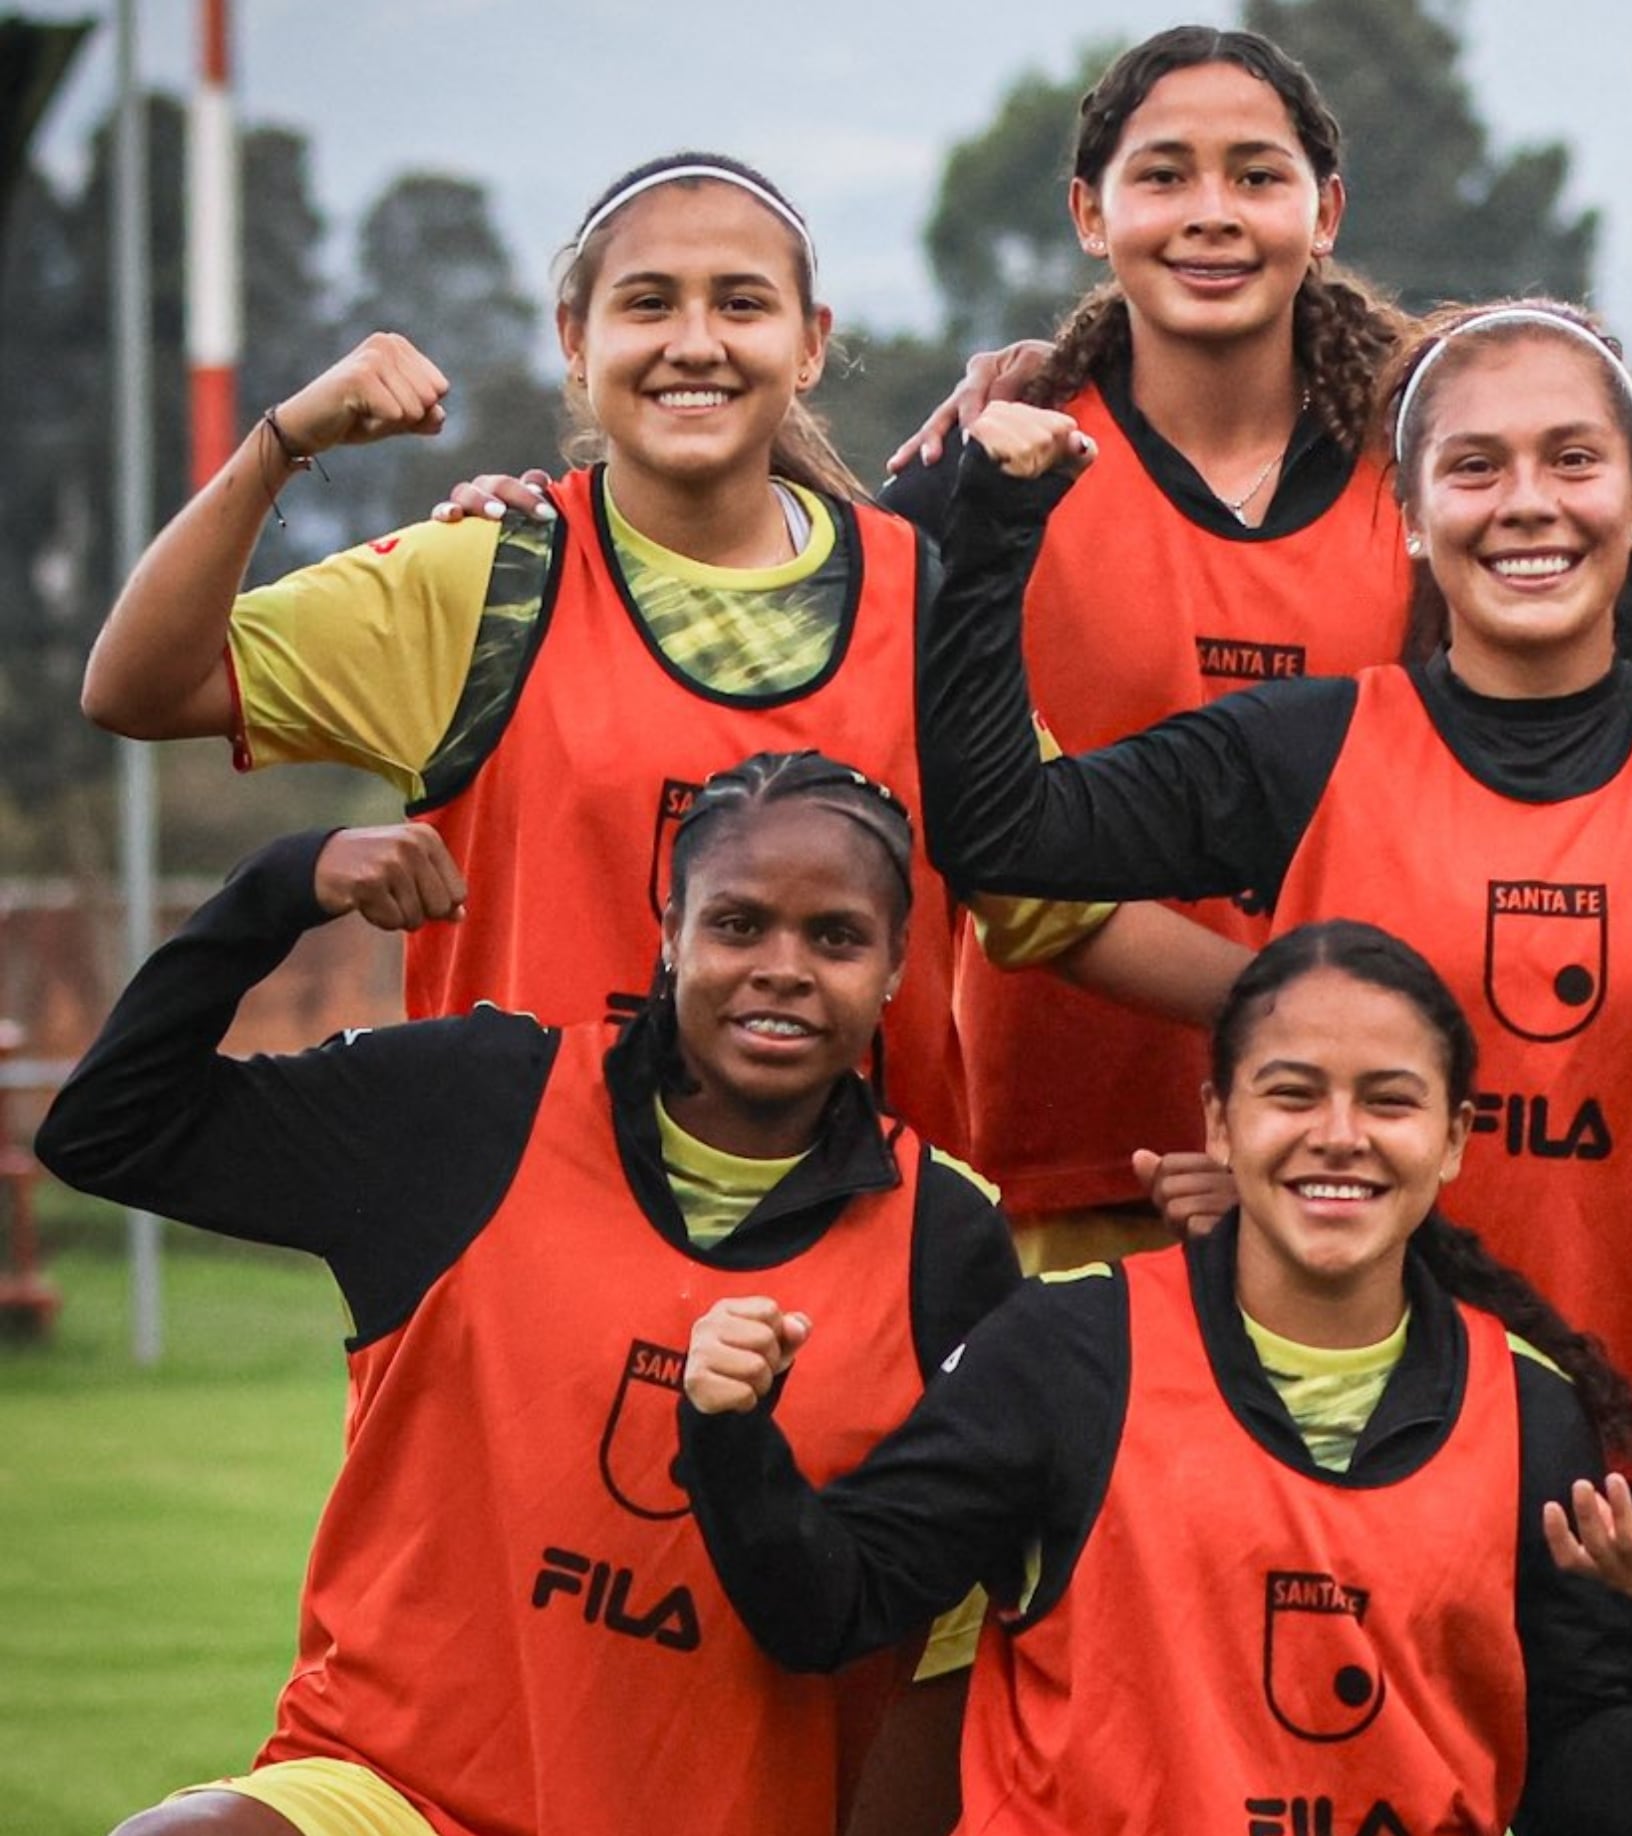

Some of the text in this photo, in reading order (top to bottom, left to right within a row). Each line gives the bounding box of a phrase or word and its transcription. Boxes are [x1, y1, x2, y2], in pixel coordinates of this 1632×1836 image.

[1273, 653, 1298, 677] FE
[1495, 886, 1600, 913] SANTA FE
[632, 1350, 682, 1385] SAN
[531, 1547, 701, 1653] FILA
[1273, 1580, 1346, 1609] SANTA
